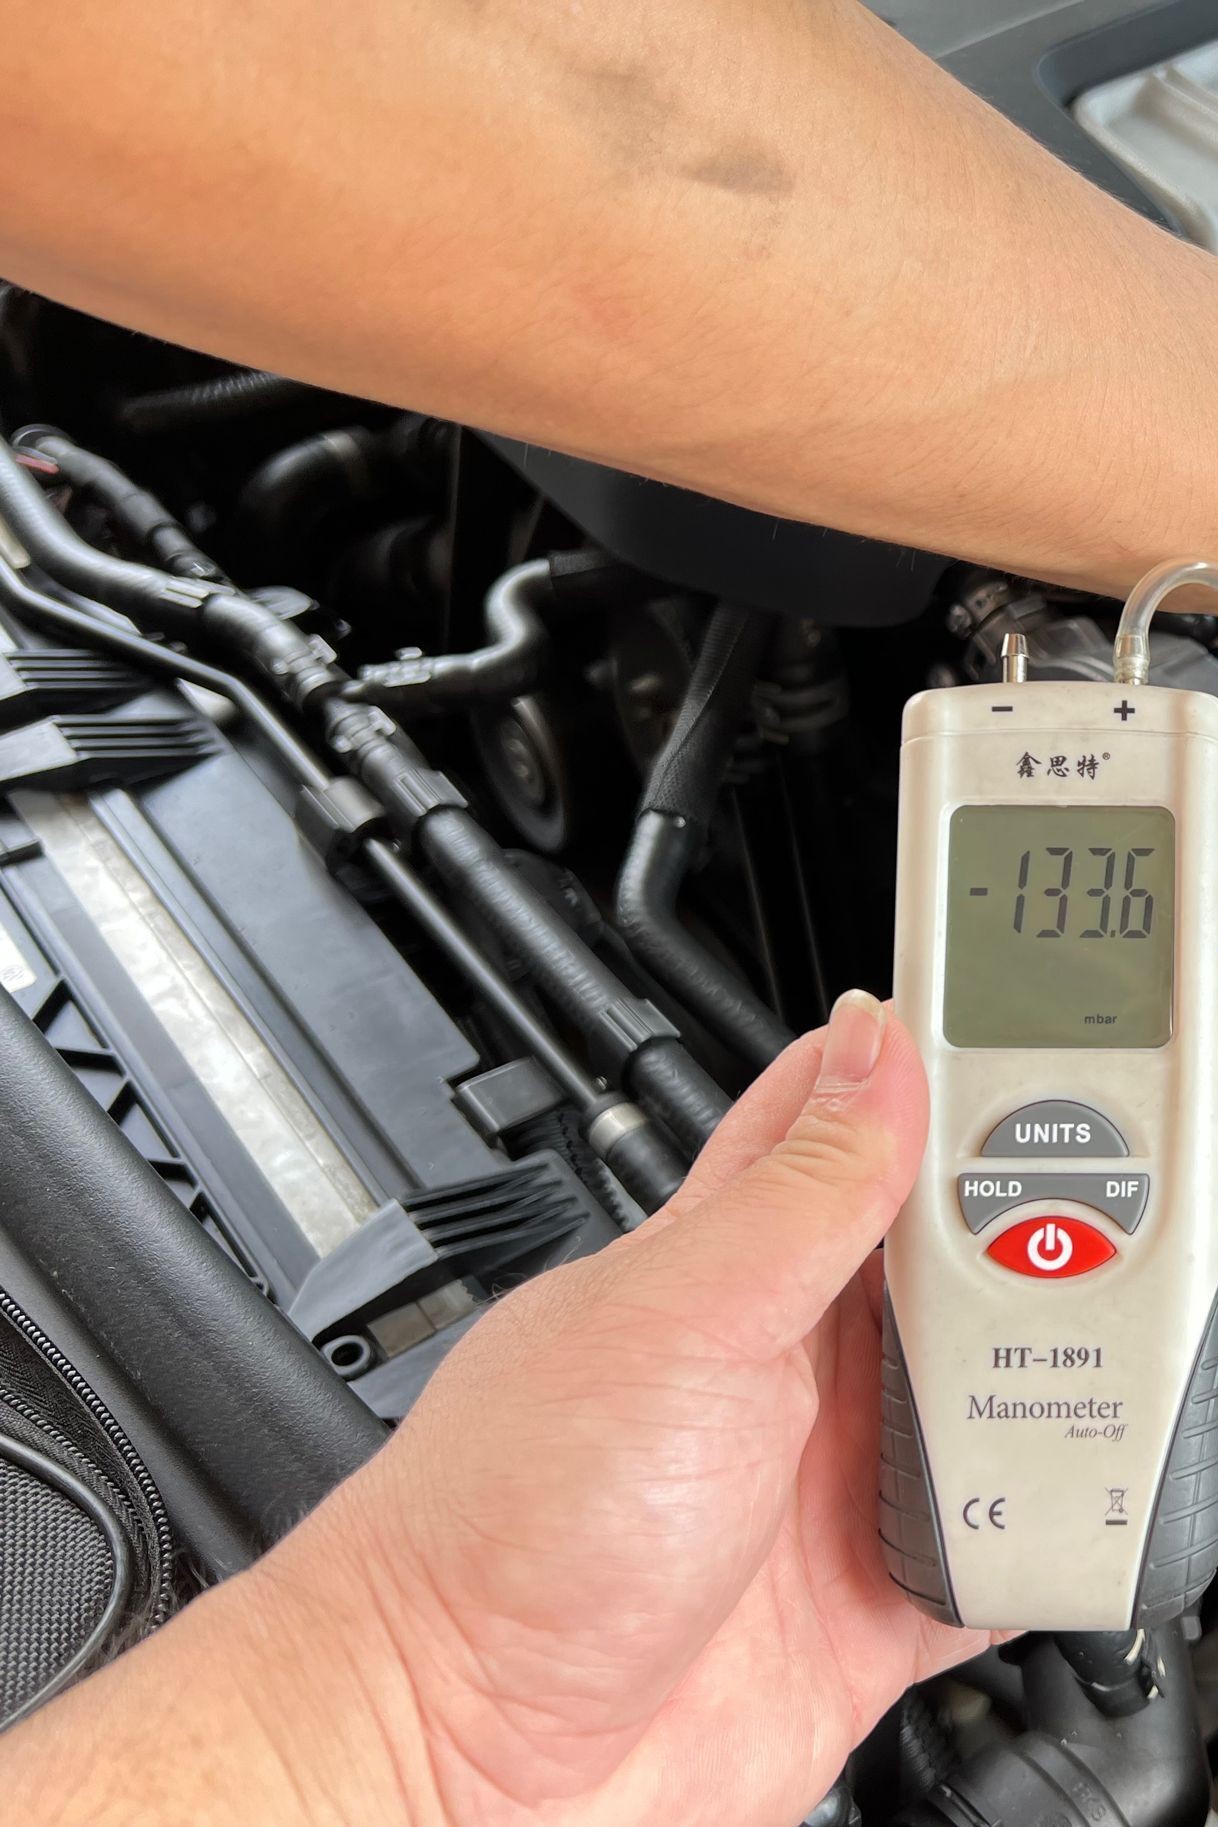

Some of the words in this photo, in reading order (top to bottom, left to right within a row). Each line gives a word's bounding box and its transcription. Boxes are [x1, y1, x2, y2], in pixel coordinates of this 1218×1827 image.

[969, 847, 1155, 938] -133.6
[1084, 1013, 1118, 1025] mbar
[1015, 1122, 1091, 1144] UNITS
[964, 1180, 1022, 1198] HOLD
[1105, 1180, 1139, 1199] DIF
[991, 1347, 1103, 1369] HT-1891
[967, 1394, 1124, 1420] Manometer
[1064, 1423, 1127, 1442] Auto-Off
